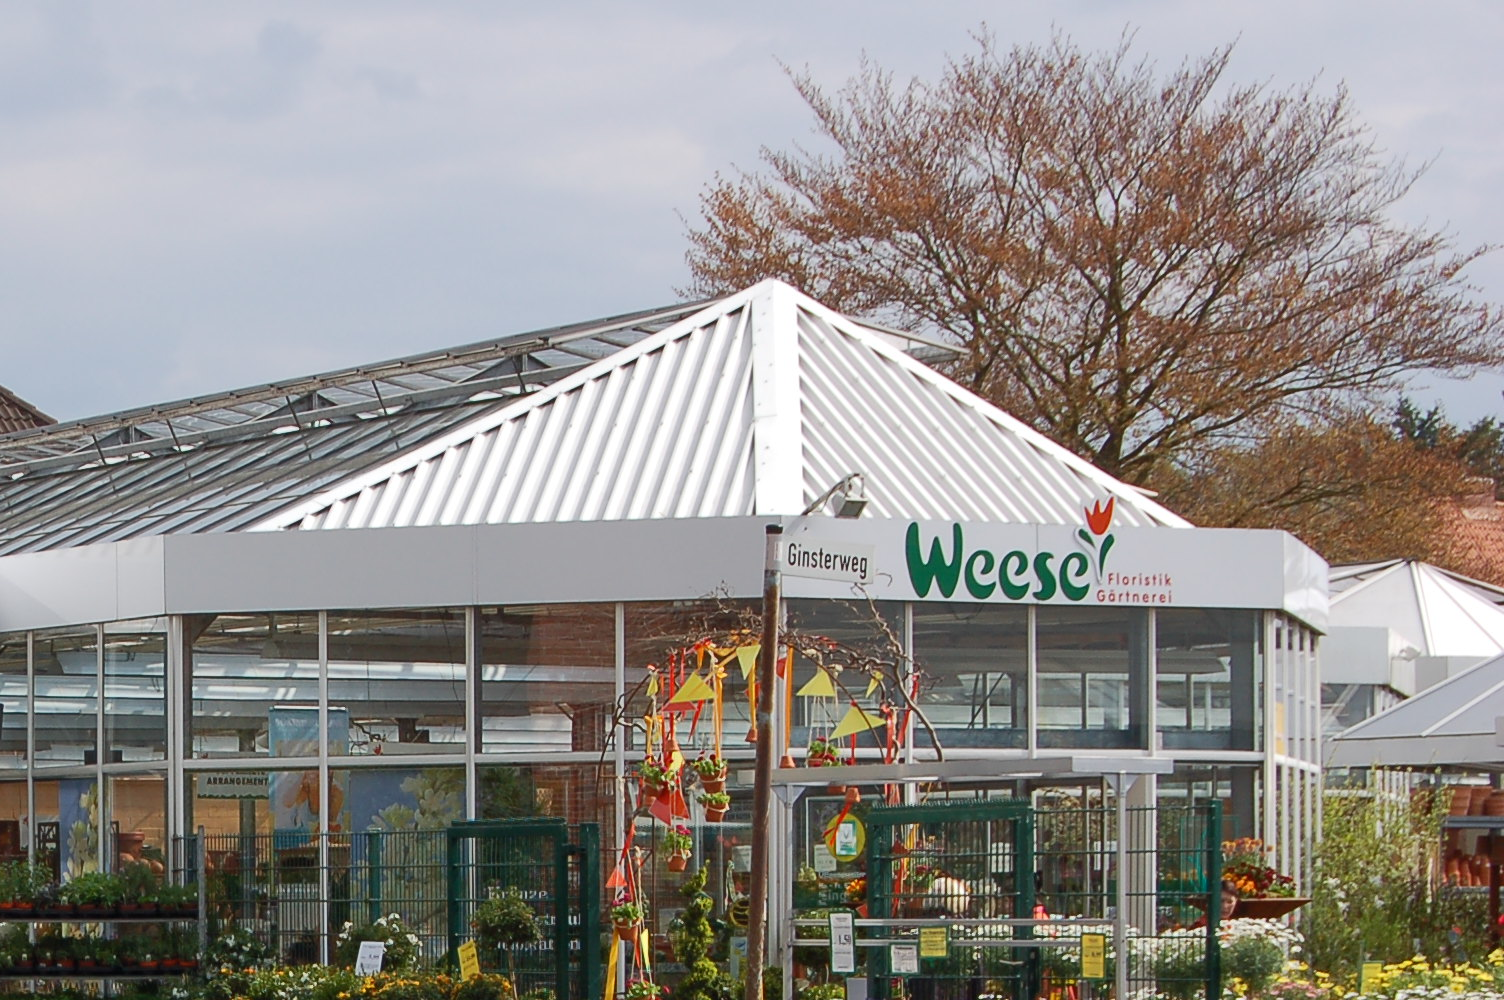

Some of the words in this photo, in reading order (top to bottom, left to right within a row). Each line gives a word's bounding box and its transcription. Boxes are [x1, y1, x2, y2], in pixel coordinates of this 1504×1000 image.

[787, 542, 868, 580] Ginsterweg
[905, 520, 1093, 602] Weese
[1107, 573, 1173, 587] Floristik
[1096, 590, 1173, 604] Gärtnerei
